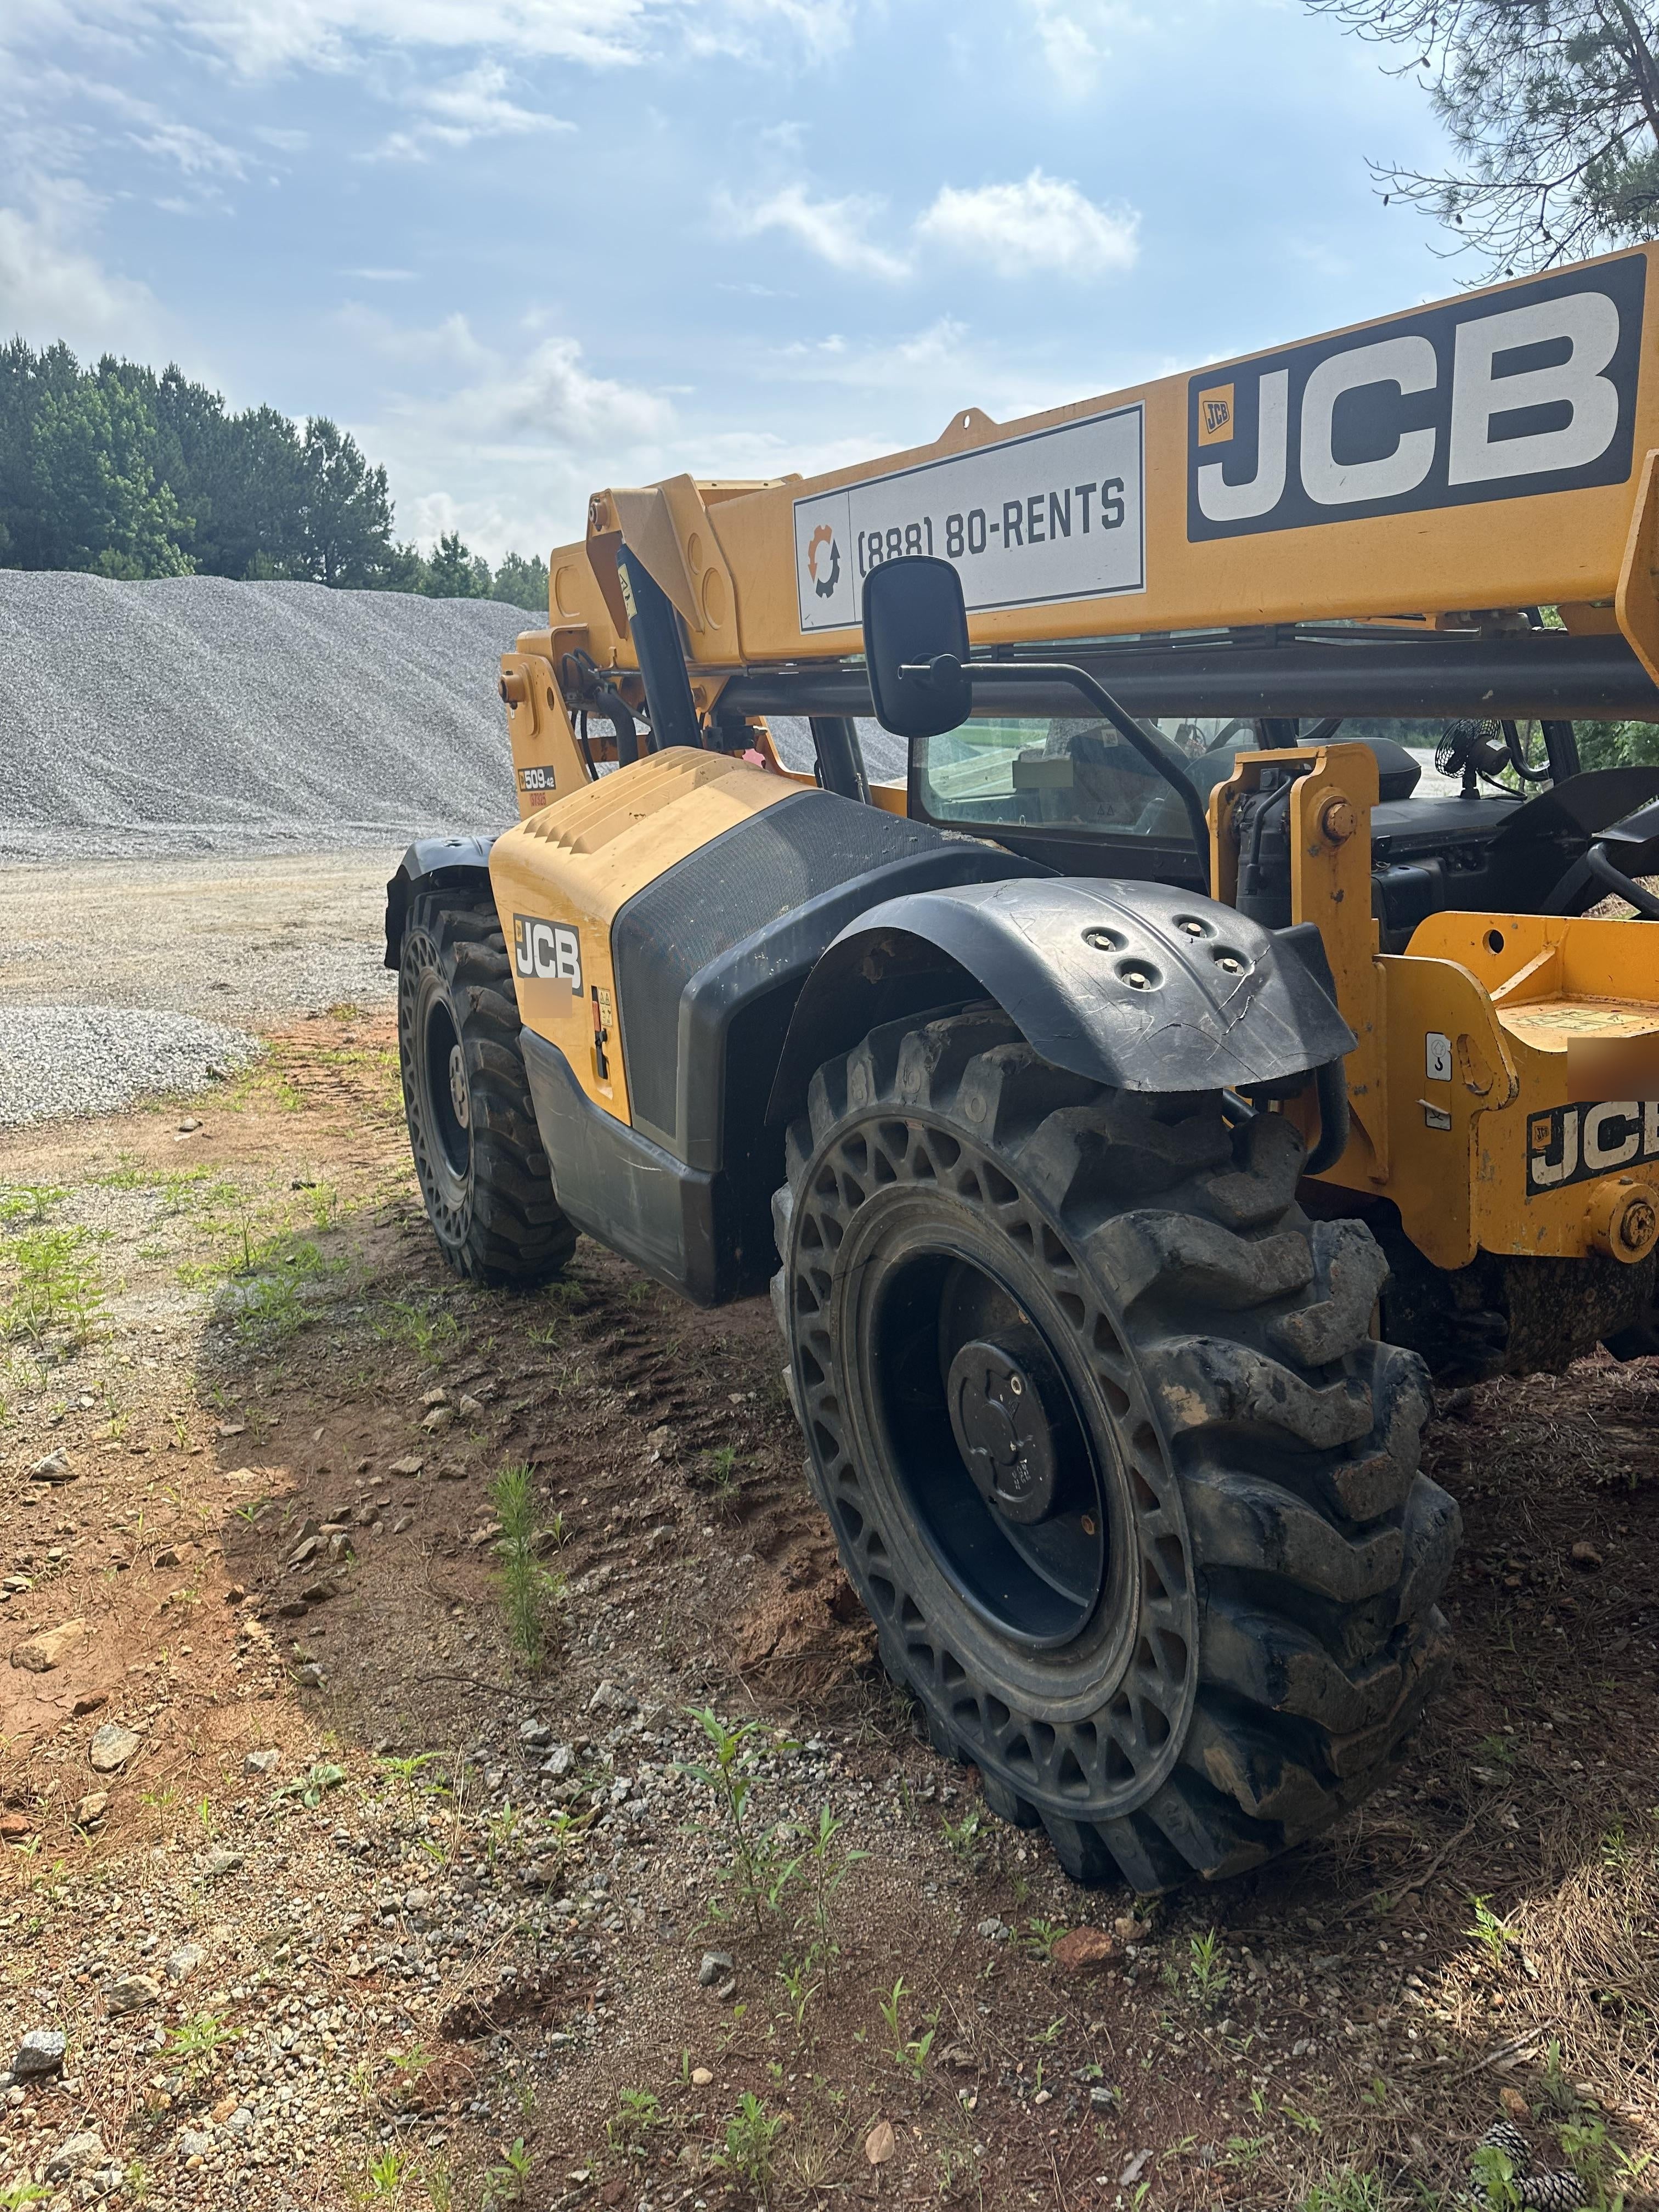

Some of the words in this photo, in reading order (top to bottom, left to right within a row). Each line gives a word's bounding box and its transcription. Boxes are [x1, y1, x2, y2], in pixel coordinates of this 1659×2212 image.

[1198, 291, 1620, 521] JCB
[1207, 404, 1228, 430] JCB
[858, 516, 933, 578] (888)
[946, 477, 1125, 559] 80-RENTS
[524, 769, 555, 789] 509-42
[516, 922, 581, 989] JCB
[1531, 1102, 1659, 1186] JC
